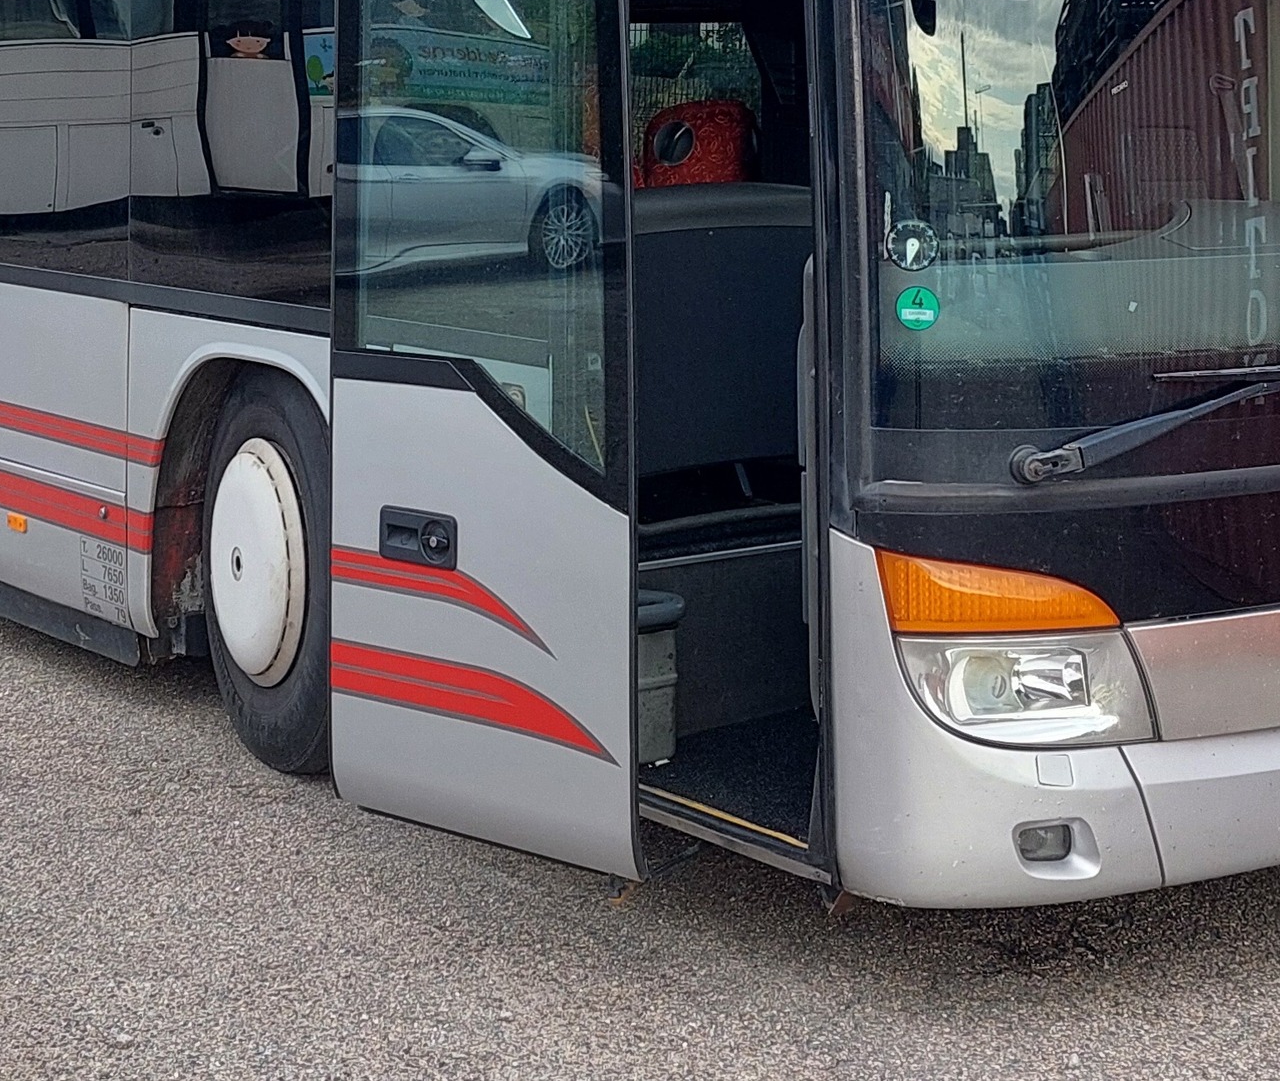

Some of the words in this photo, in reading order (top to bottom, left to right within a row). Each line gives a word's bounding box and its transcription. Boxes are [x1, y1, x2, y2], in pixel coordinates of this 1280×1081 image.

[911, 289, 924, 309] 4
[96, 544, 124, 567] 26000
[101, 565, 124, 586] 7650
[103, 584, 124, 605] 1350
[115, 607, 127, 623] 79
